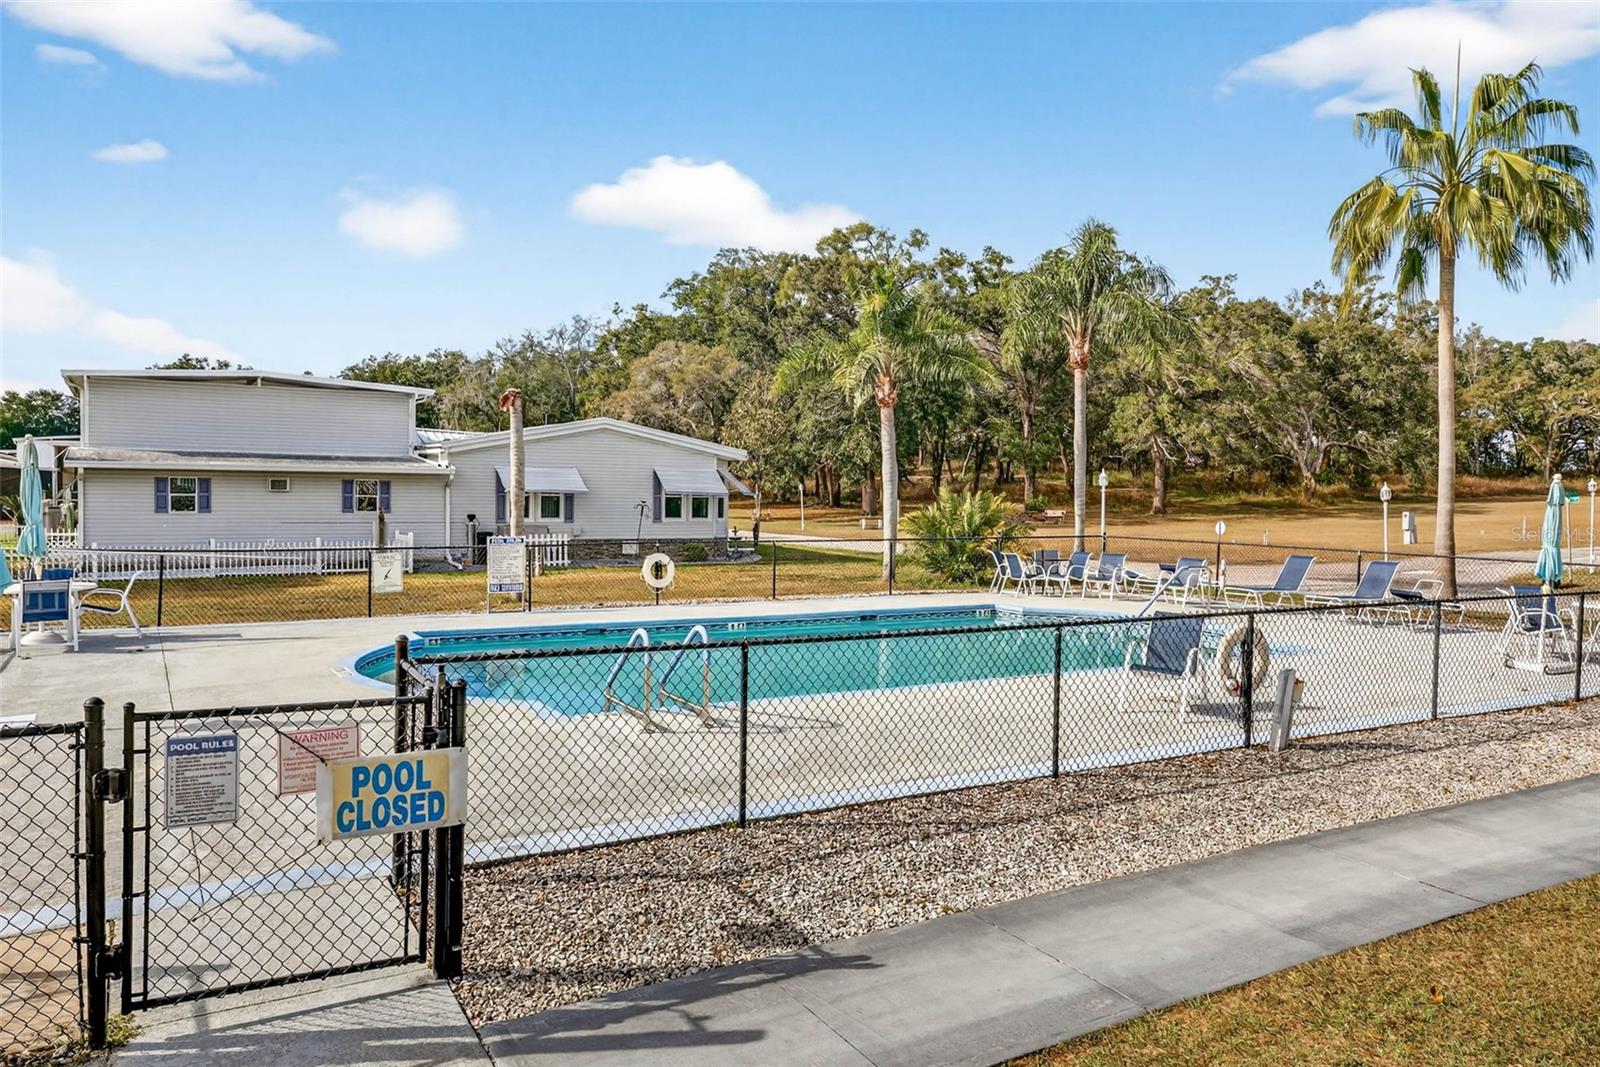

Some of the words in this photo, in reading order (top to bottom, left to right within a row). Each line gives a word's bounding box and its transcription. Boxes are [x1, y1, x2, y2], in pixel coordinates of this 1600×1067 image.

[170, 743, 200, 752] POOL
[201, 740, 234, 749] RULES
[289, 730, 349, 743] WARNING
[351, 759, 432, 798] POOL
[336, 790, 445, 833] CLOSED
